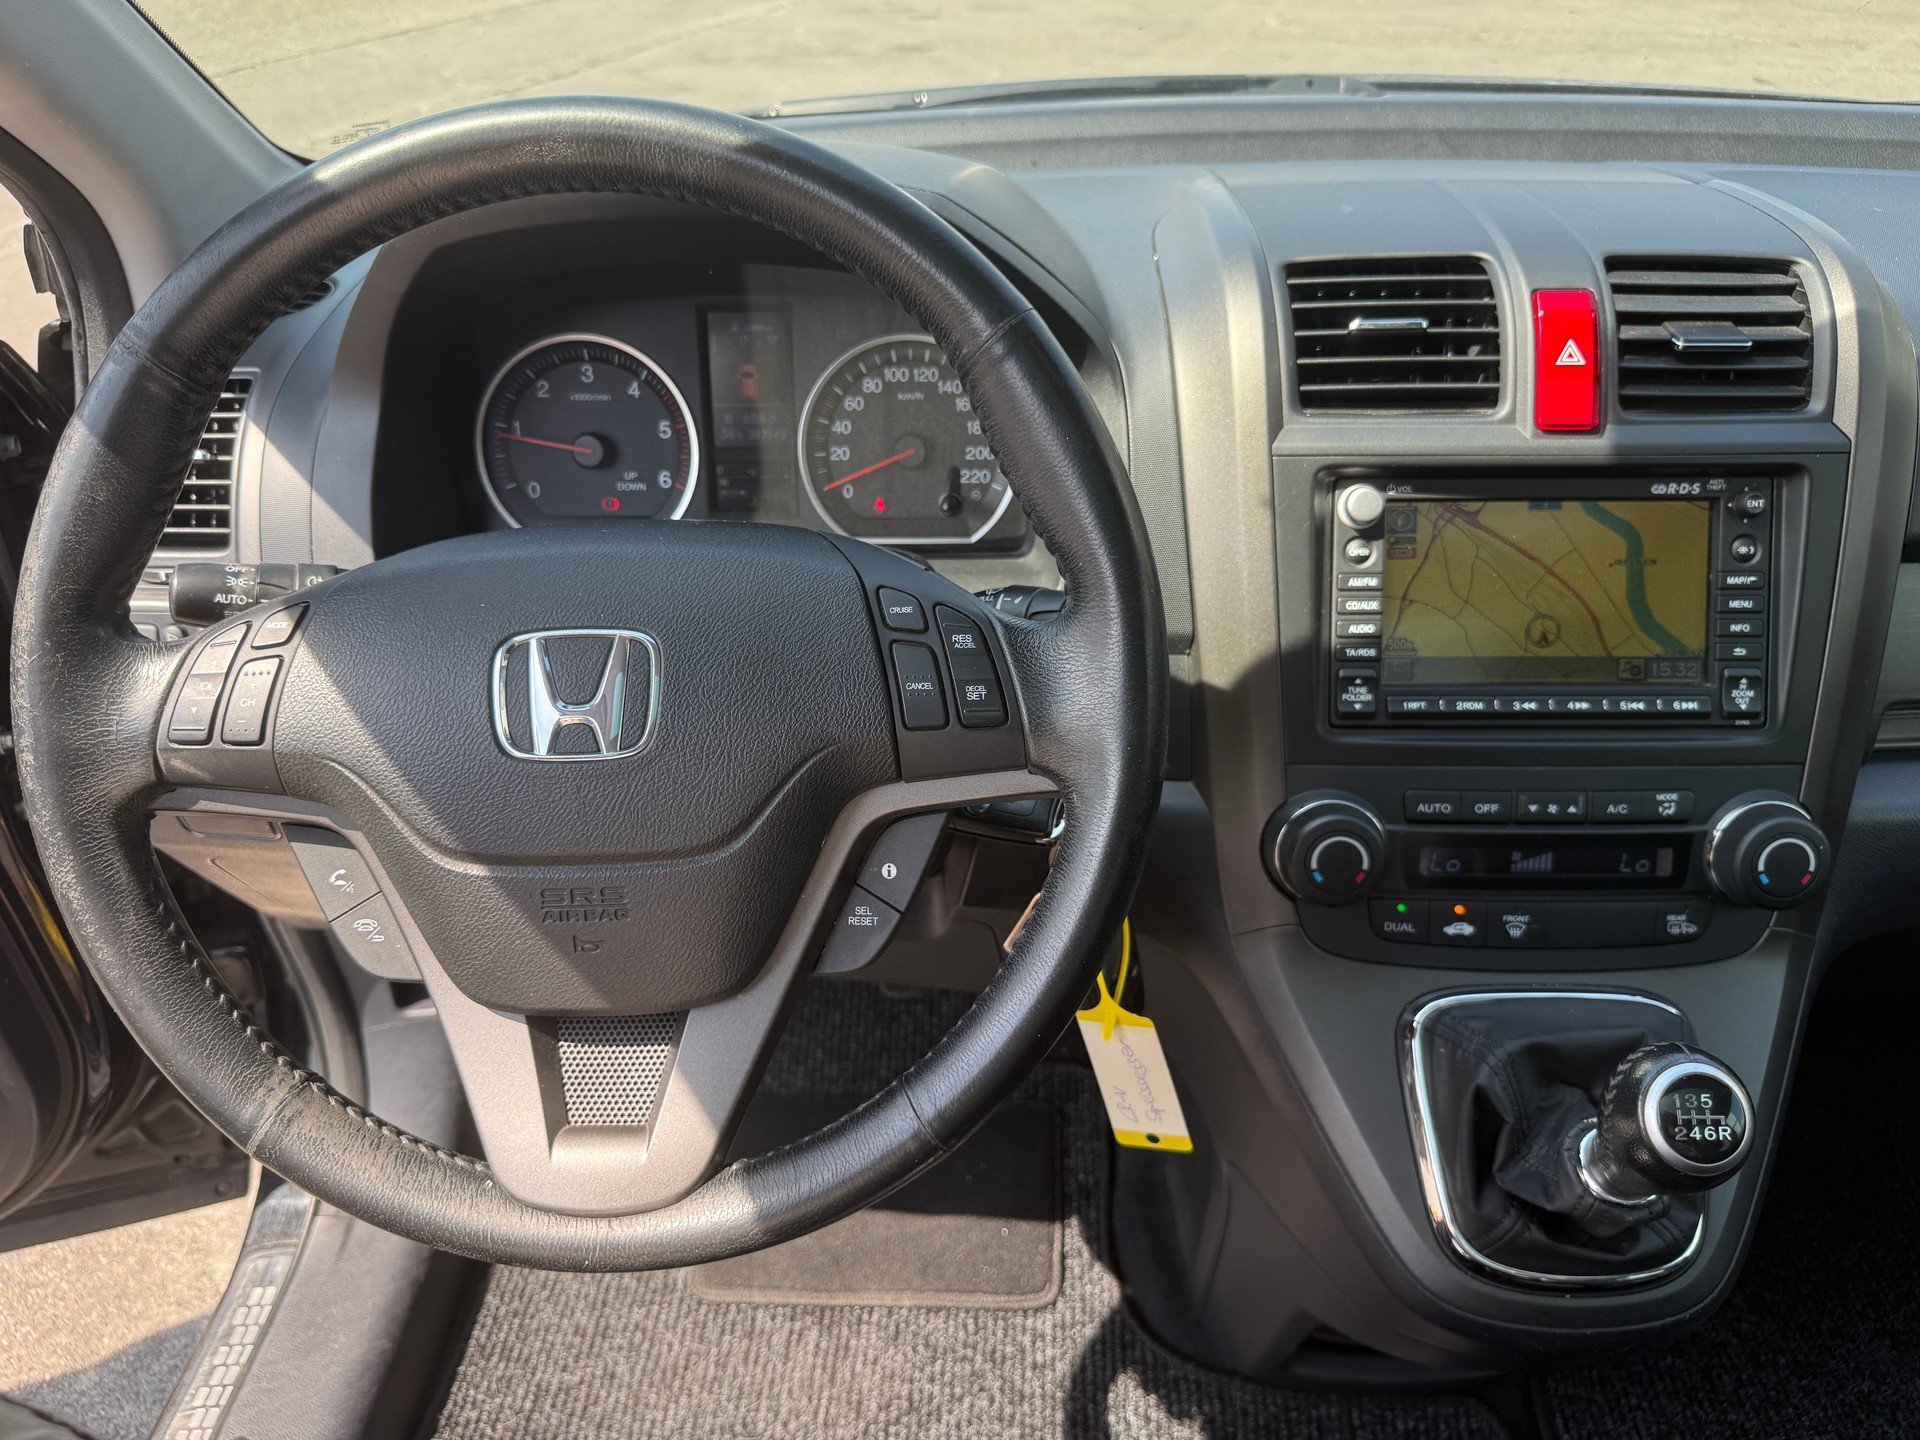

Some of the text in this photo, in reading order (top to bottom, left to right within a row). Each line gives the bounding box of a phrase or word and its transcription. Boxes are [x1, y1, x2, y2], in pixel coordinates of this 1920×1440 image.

[580, 365, 594, 383] 3
[884, 368, 909, 382] 100
[913, 368, 938, 382] 120
[536, 380, 550, 398] 2
[628, 382, 641, 399] 4
[863, 380, 882, 393] 80
[938, 381, 962, 394] 140
[844, 397, 864, 411] 60
[658, 420, 671, 439] 5
[832, 421, 850, 434] 40
[831, 448, 849, 460] 20
[624, 472, 638, 481] UP
[658, 470, 671, 488] 6
[960, 470, 991, 484] 220
[528, 482, 540, 498] 0
[616, 482, 647, 491] DOWN
[842, 486, 854, 498] 0
[1349, 548, 1370, 556] OPEN
[1348, 577, 1377, 587] AM/FM
[214, 593, 247, 605] AUTO
[1728, 600, 1753, 608] MENU
[1346, 602, 1378, 610] CD/AUX
[1348, 624, 1376, 633] AUDIO
[1729, 624, 1750, 632] INFO
[952, 635, 972, 643] RES
[1345, 648, 1376, 657] TA/RDS
[905, 682, 934, 690] CANCEL
[966, 692, 987, 701] SET
[241, 698, 256, 707] CH
[1656, 793, 1679, 801] MODE
[1416, 803, 1451, 813] AUTO
[1474, 803, 1500, 814] OFF
[1606, 804, 1628, 814] A/C
[541, 887, 627, 905] SRS
[541, 908, 630, 923] AIRBAG
[855, 906, 872, 915] SEL
[848, 917, 878, 926] RESET
[1384, 922, 1416, 932] DUAL
